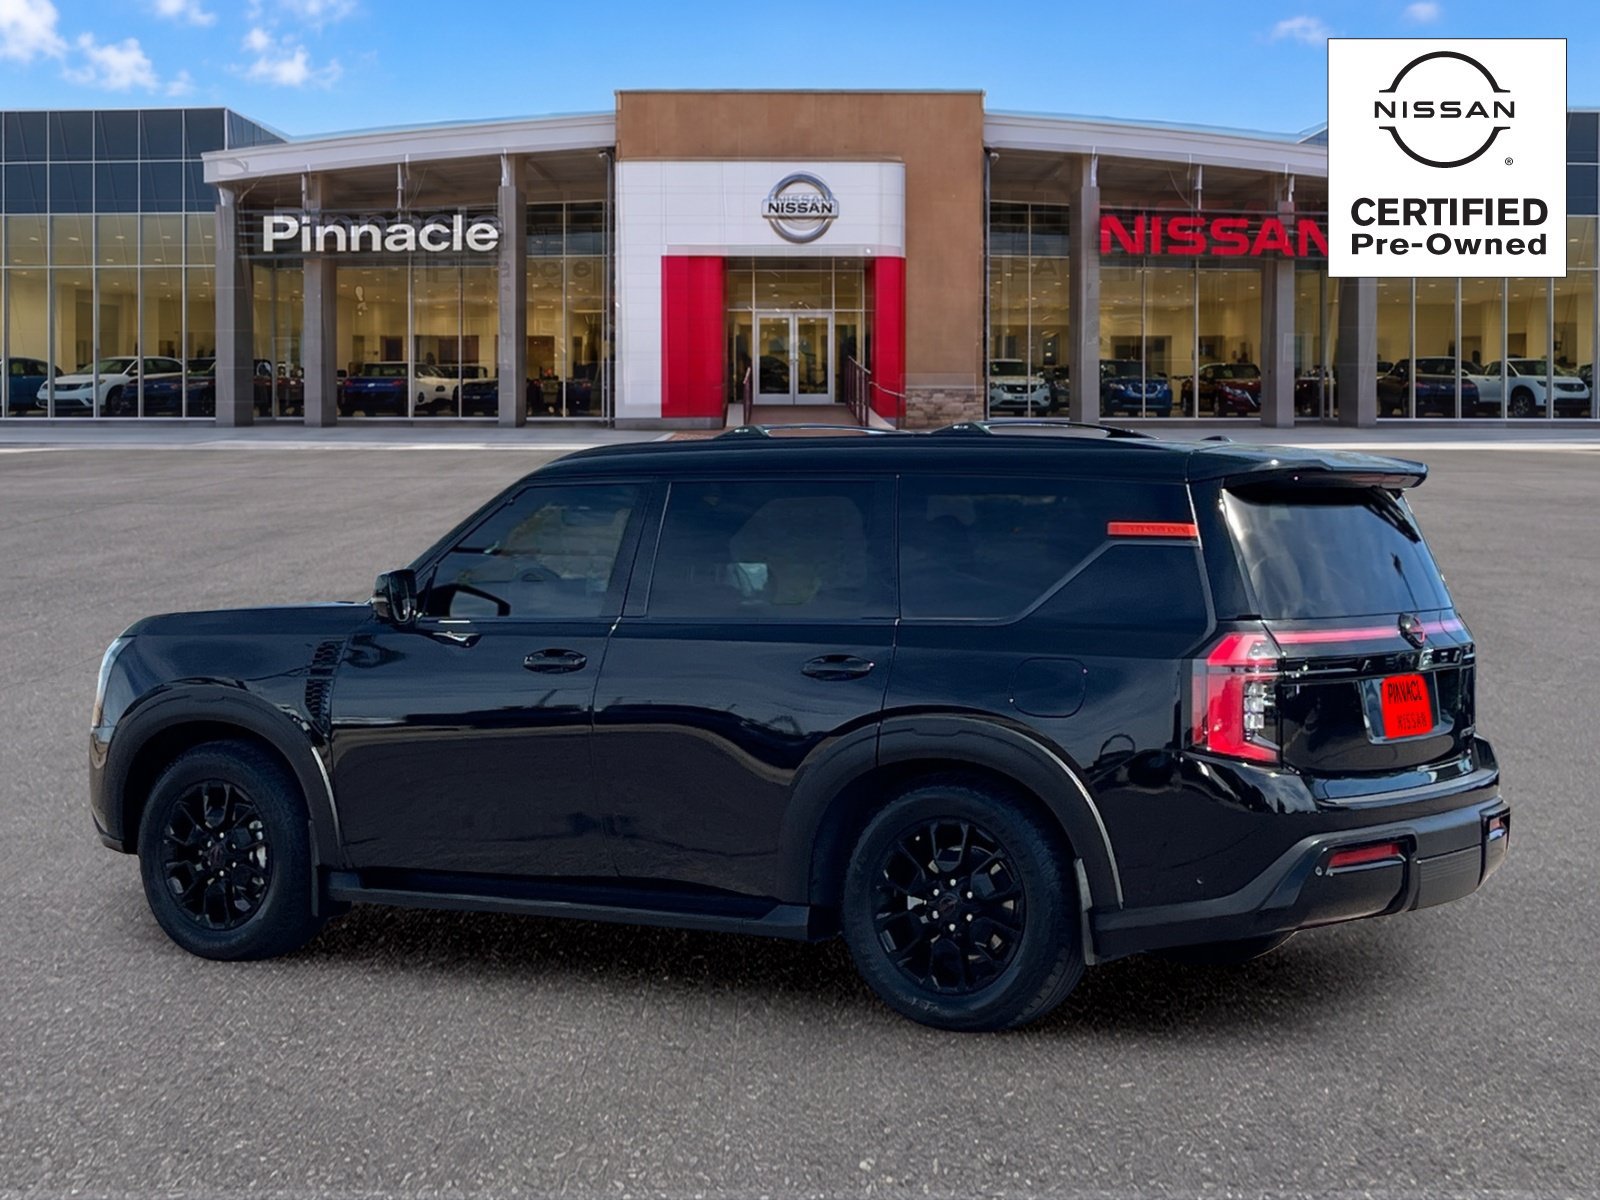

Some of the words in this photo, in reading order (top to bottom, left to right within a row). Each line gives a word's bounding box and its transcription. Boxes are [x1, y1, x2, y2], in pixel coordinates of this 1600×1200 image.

[767, 202, 833, 214] NISSAN
[263, 215, 499, 252] Pinnacle
[1100, 215, 1328, 257] NISSAN
